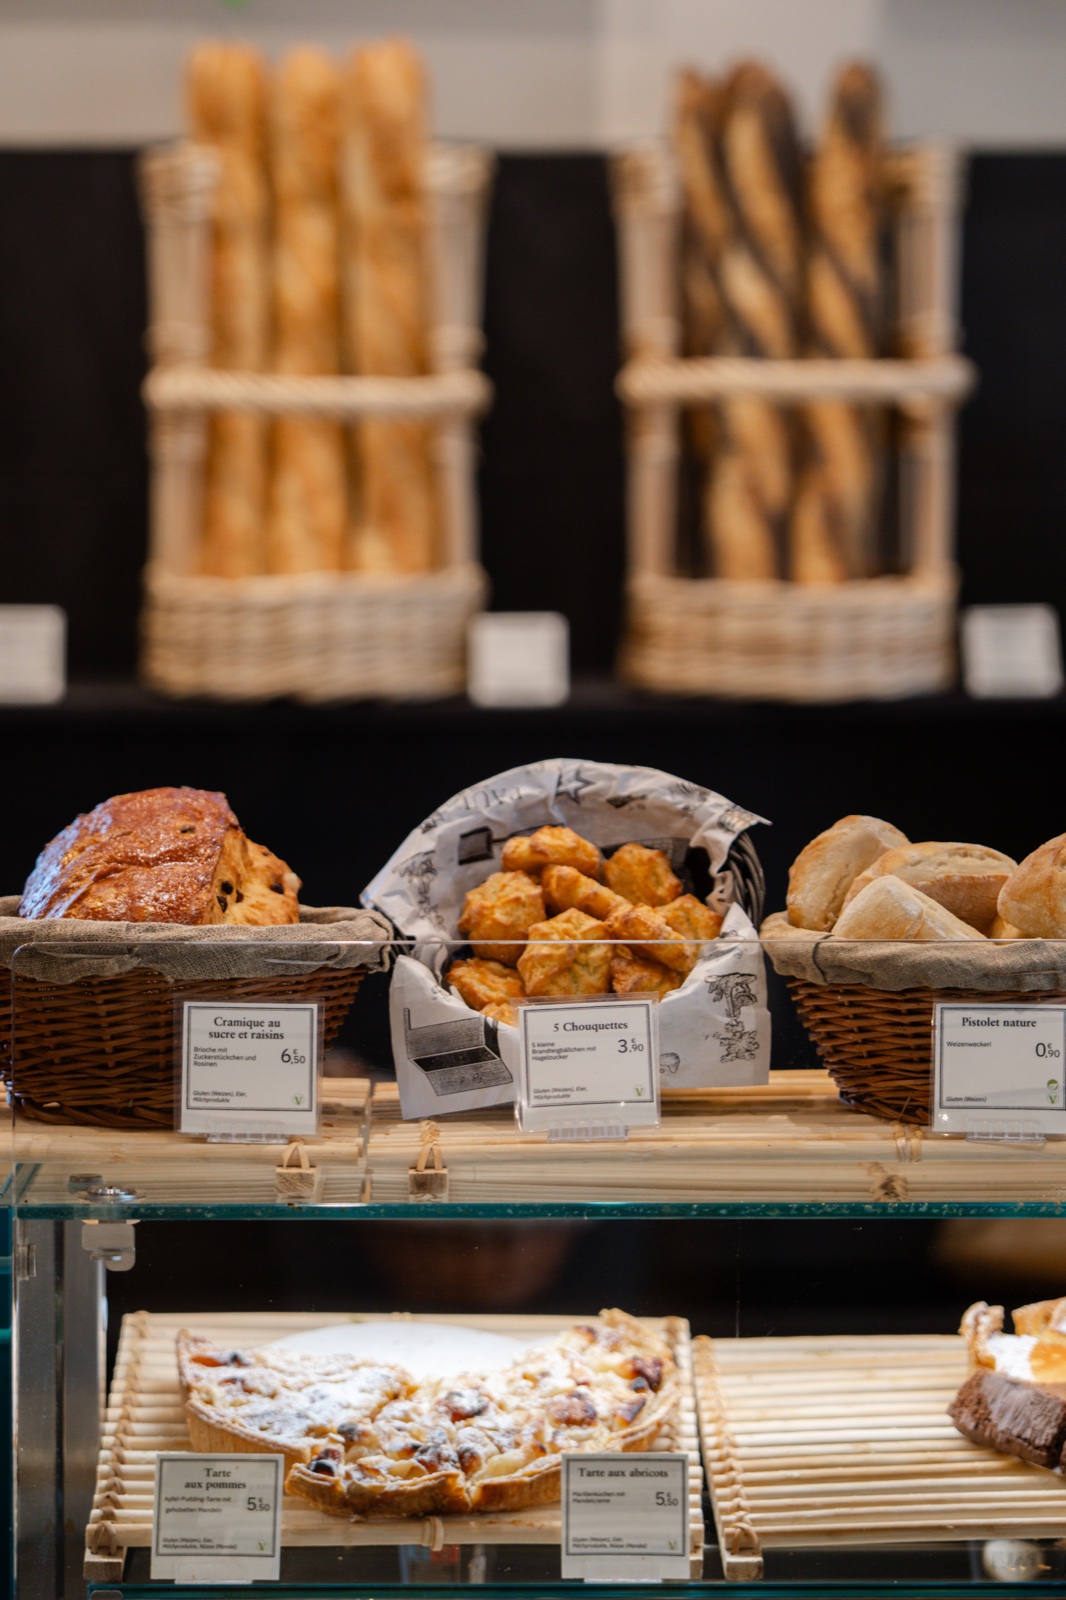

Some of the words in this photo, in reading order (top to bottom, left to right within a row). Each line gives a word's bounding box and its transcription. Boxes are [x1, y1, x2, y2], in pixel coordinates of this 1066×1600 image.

[214, 1017, 265, 1029] Cramique
[268, 1020, 281, 1028] au
[962, 1017, 999, 1026] Pistolet
[552, 1022, 560, 1033] 5
[563, 1022, 628, 1032] Chouquettes
[251, 1030, 284, 1039] raisins
[532, 1054, 569, 1062] Hagelzucker
[204, 1468, 231, 1477] Tarte
[578, 1467, 605, 1477] Tarte
[629, 1468, 668, 1477] abricots
[205, 1482, 246, 1491] pommes
